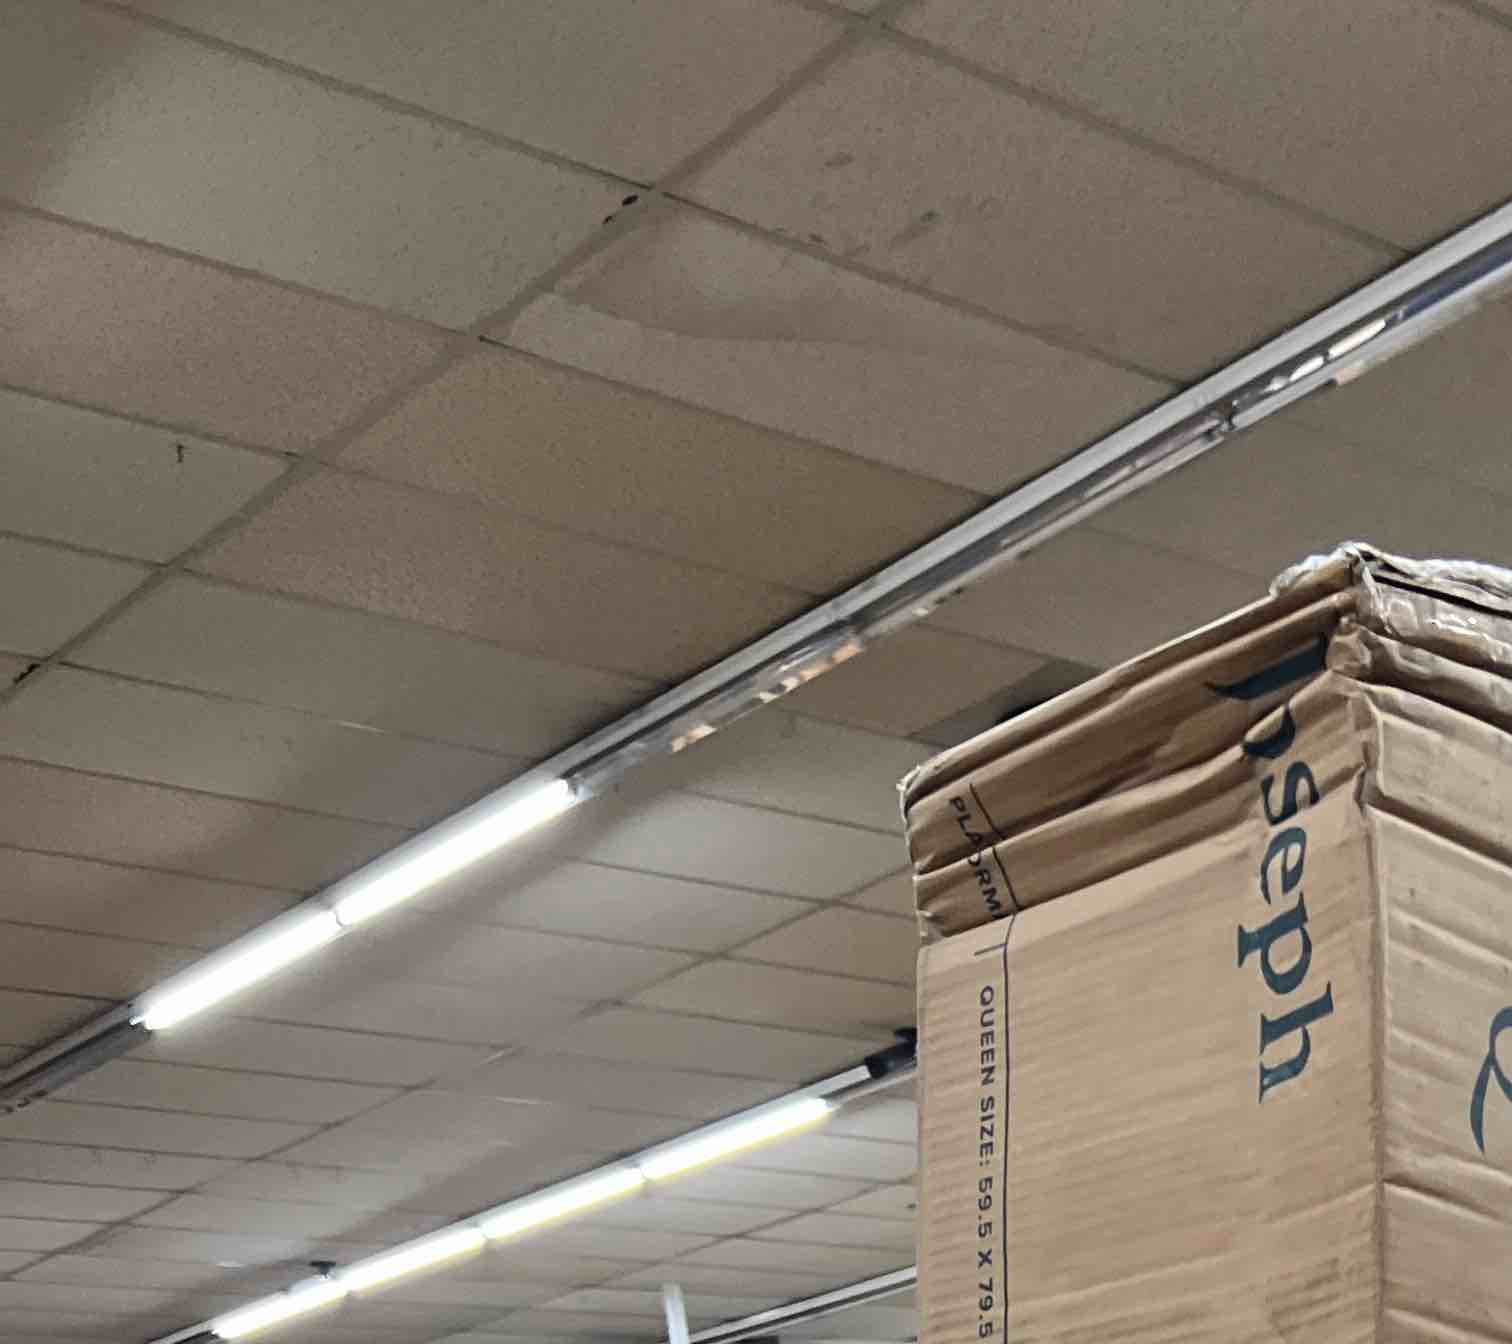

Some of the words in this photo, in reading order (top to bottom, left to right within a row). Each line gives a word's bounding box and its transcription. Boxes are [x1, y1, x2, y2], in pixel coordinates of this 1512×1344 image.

[979, 985, 995, 1086] QUEEN
[979, 1095, 995, 1167] SIZE:
[977, 1177, 993, 1239] 59.5
[977, 1249, 993, 1268] X
[978, 1277, 993, 1338] 79.5
